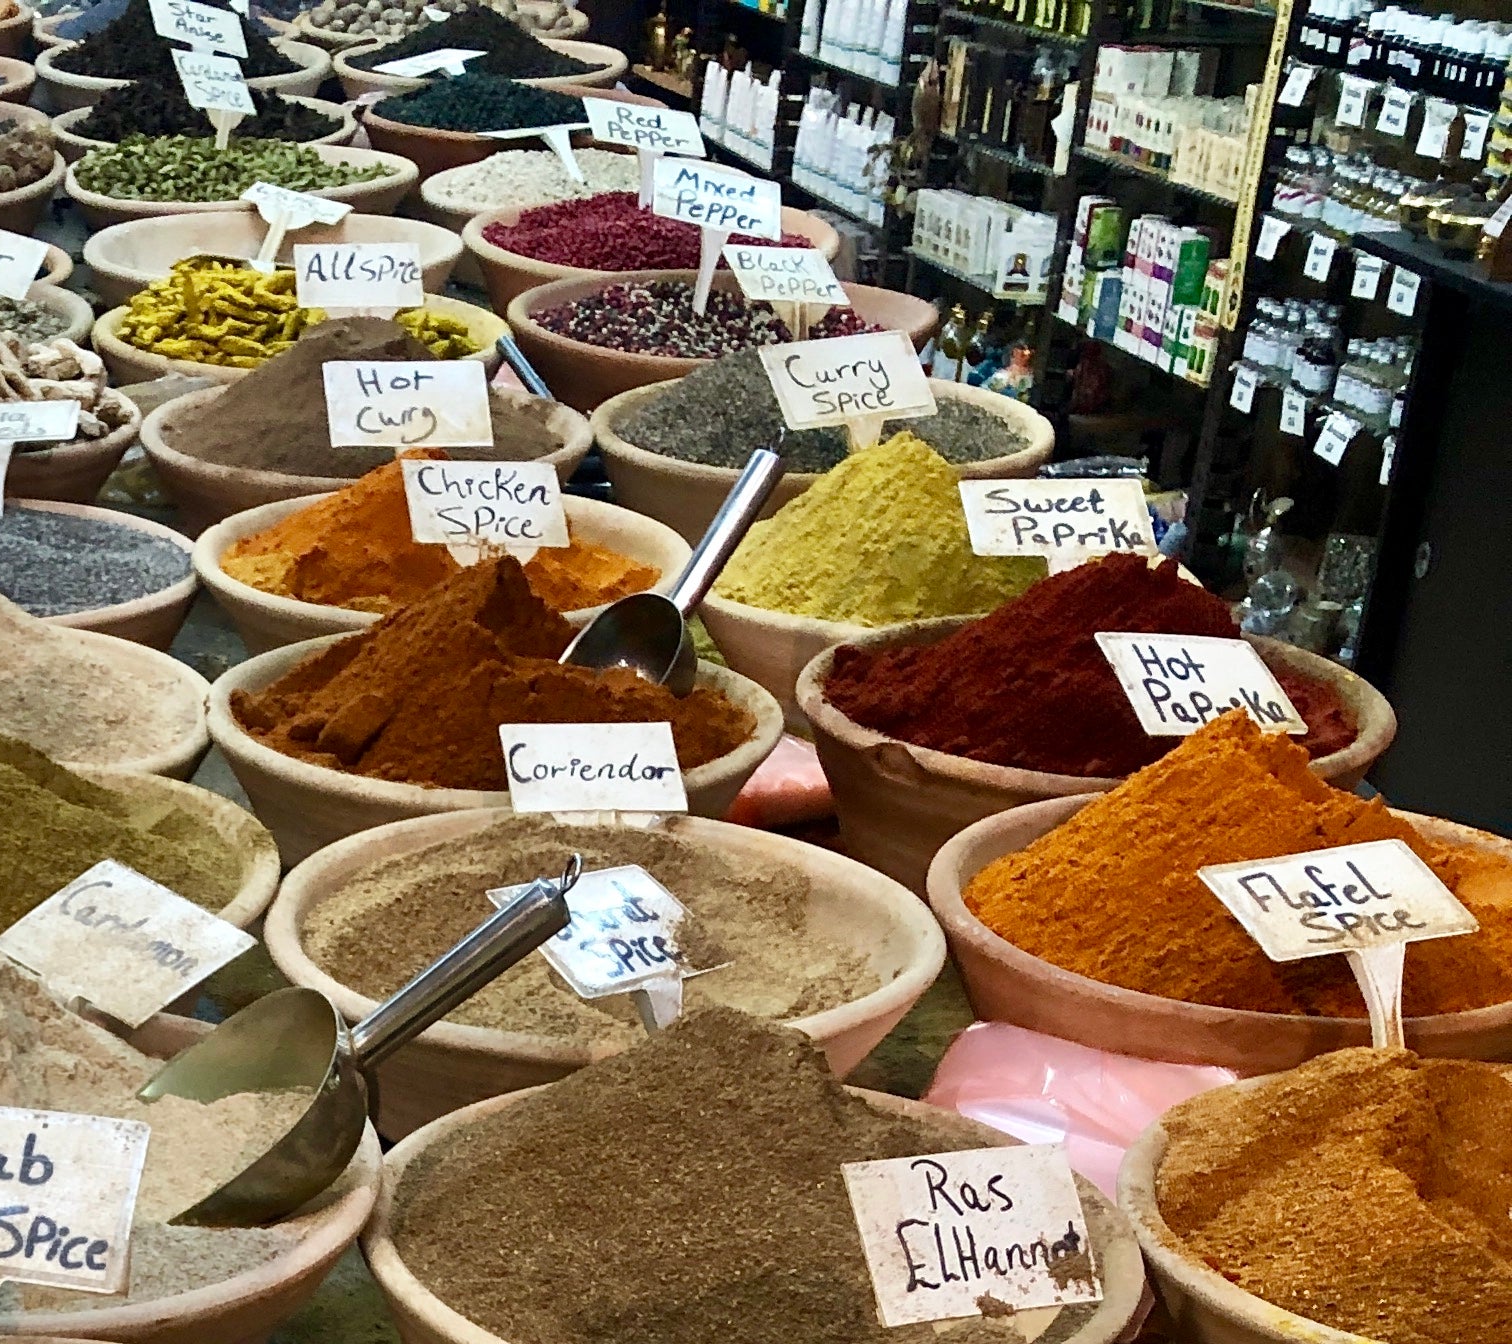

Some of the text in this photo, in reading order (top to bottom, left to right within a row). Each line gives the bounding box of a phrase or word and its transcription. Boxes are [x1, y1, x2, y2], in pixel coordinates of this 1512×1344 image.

[616, 106, 668, 131] Red
[356, 368, 433, 397] Hot
[785, 354, 891, 391] Curry
[984, 488, 1105, 515] Sweet
[1132, 643, 1206, 683] Hot
[910, 1158, 1013, 1216] Ras
